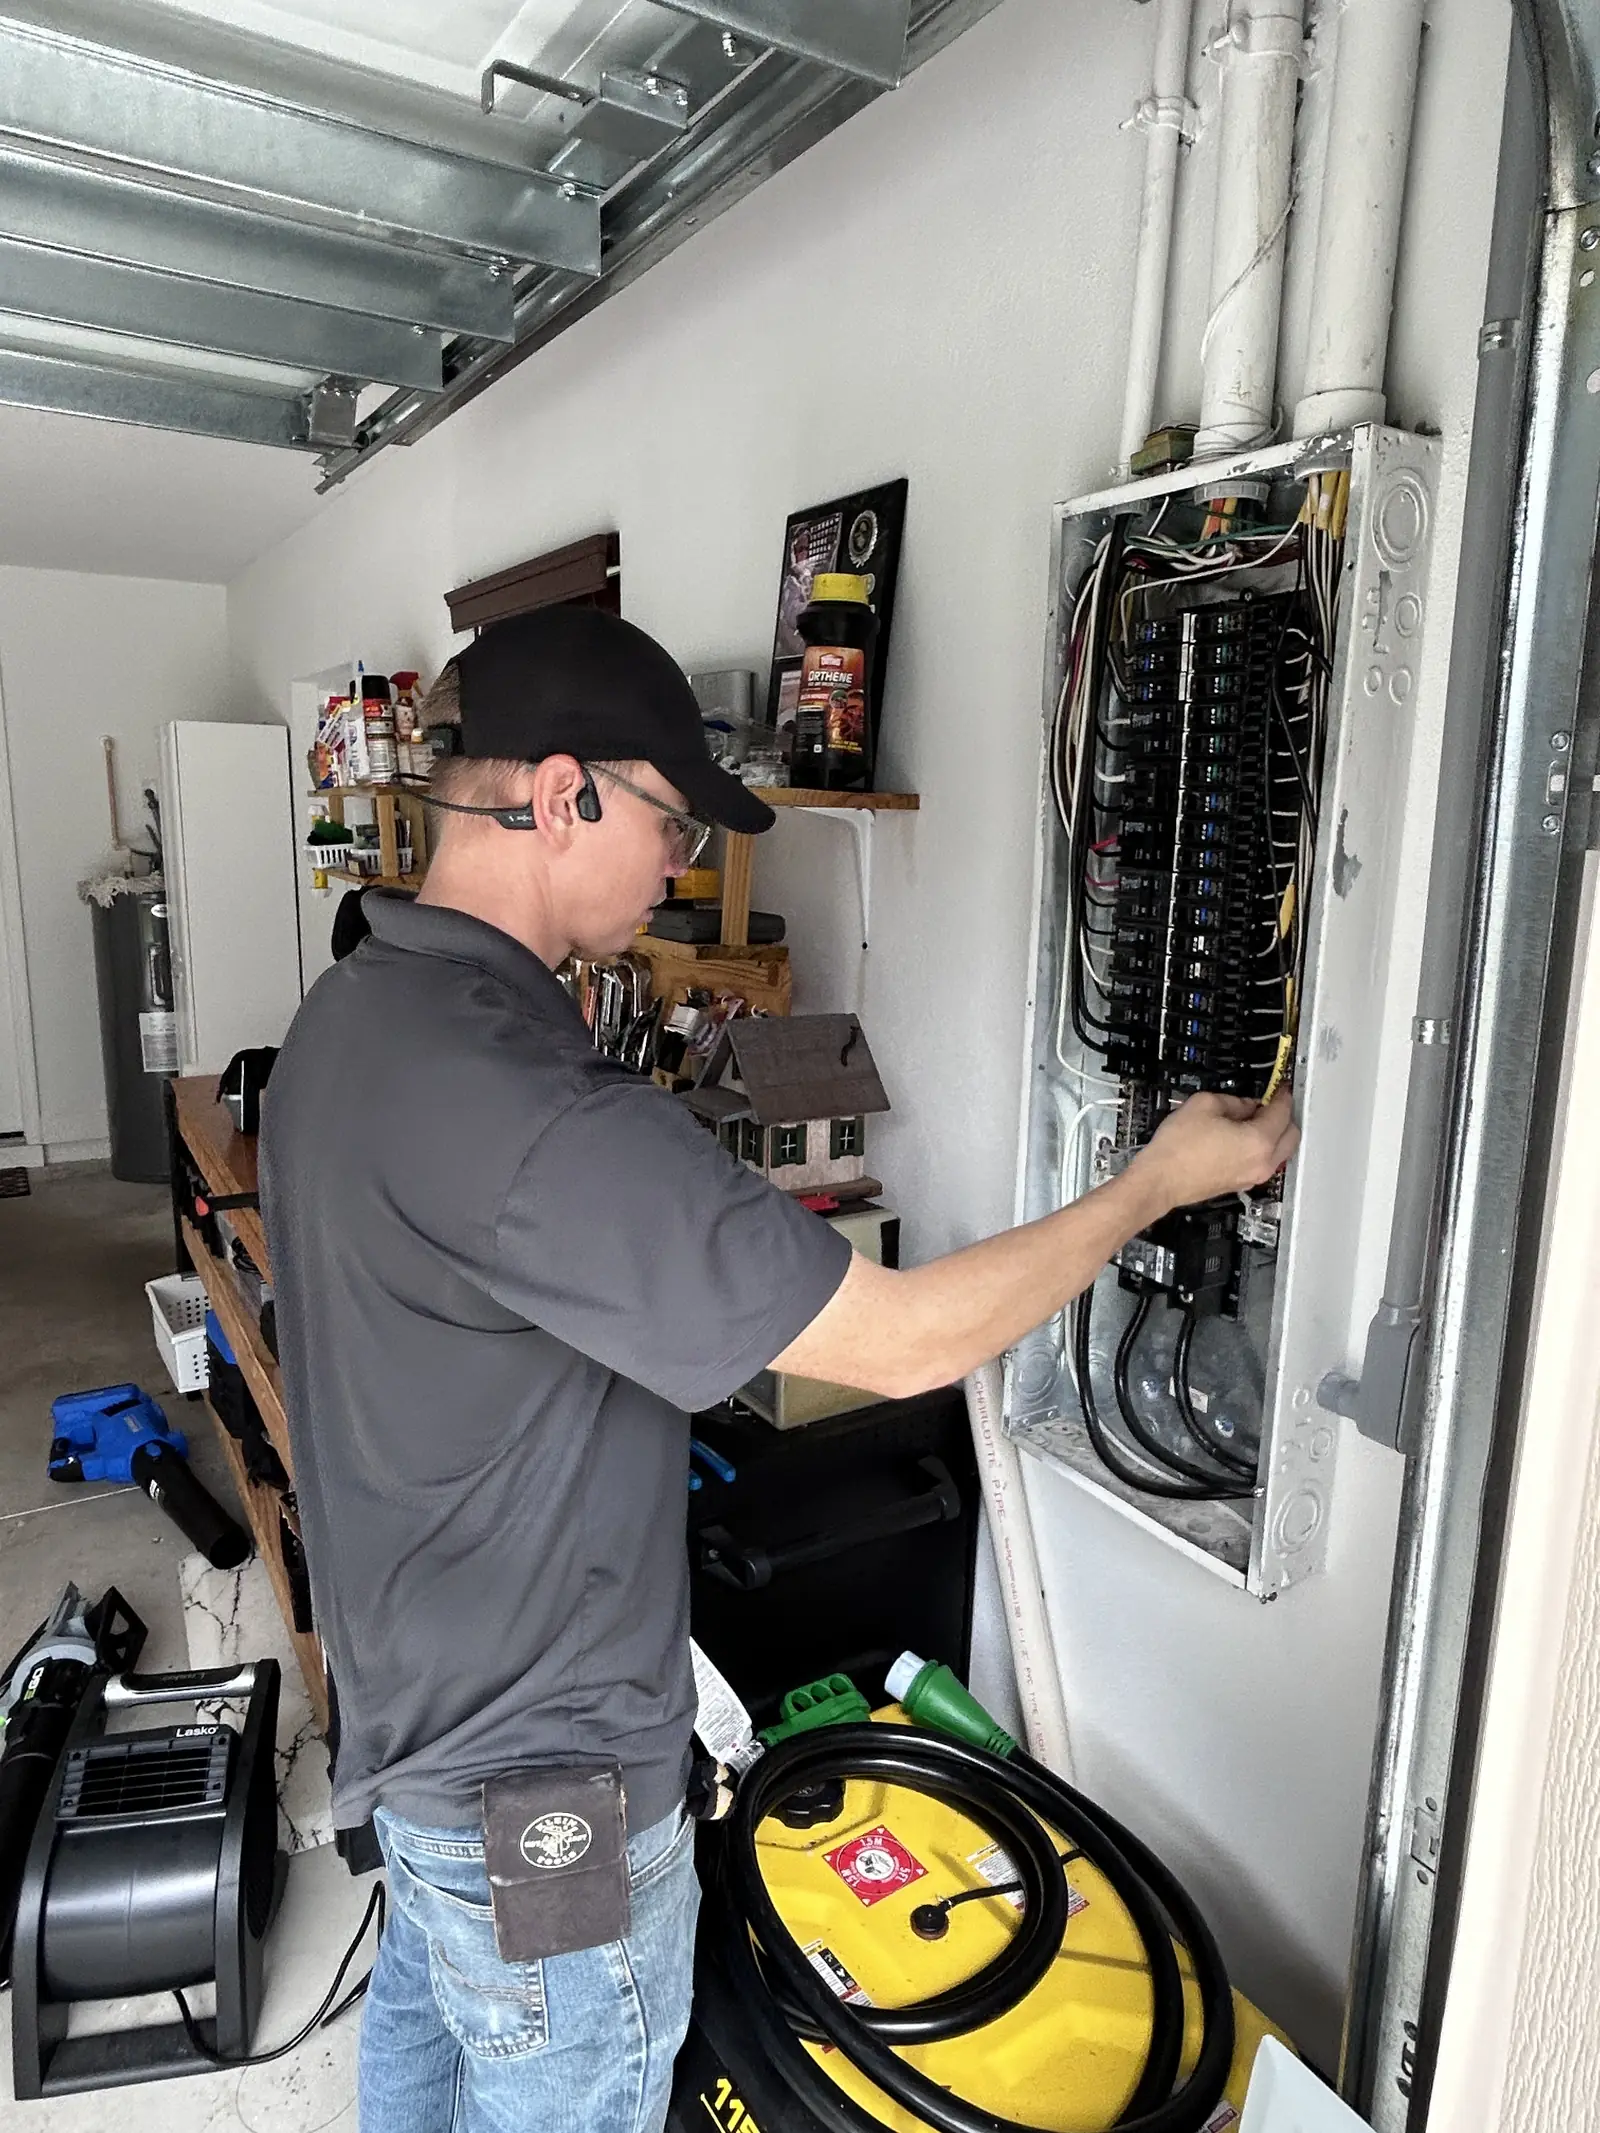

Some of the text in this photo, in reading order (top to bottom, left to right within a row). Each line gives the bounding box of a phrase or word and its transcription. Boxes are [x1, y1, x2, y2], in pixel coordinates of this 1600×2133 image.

[808, 671, 853, 683] ORTHENE
[974, 1380, 997, 1468] CHARLOTTE
[992, 1479, 1006, 1518] PIPE
[24, 1667, 45, 1700] EGO
[1024, 1666, 1034, 1685] PVC
[1028, 1690, 1039, 1716] TYPE
[176, 1725, 218, 1738] Lasko
